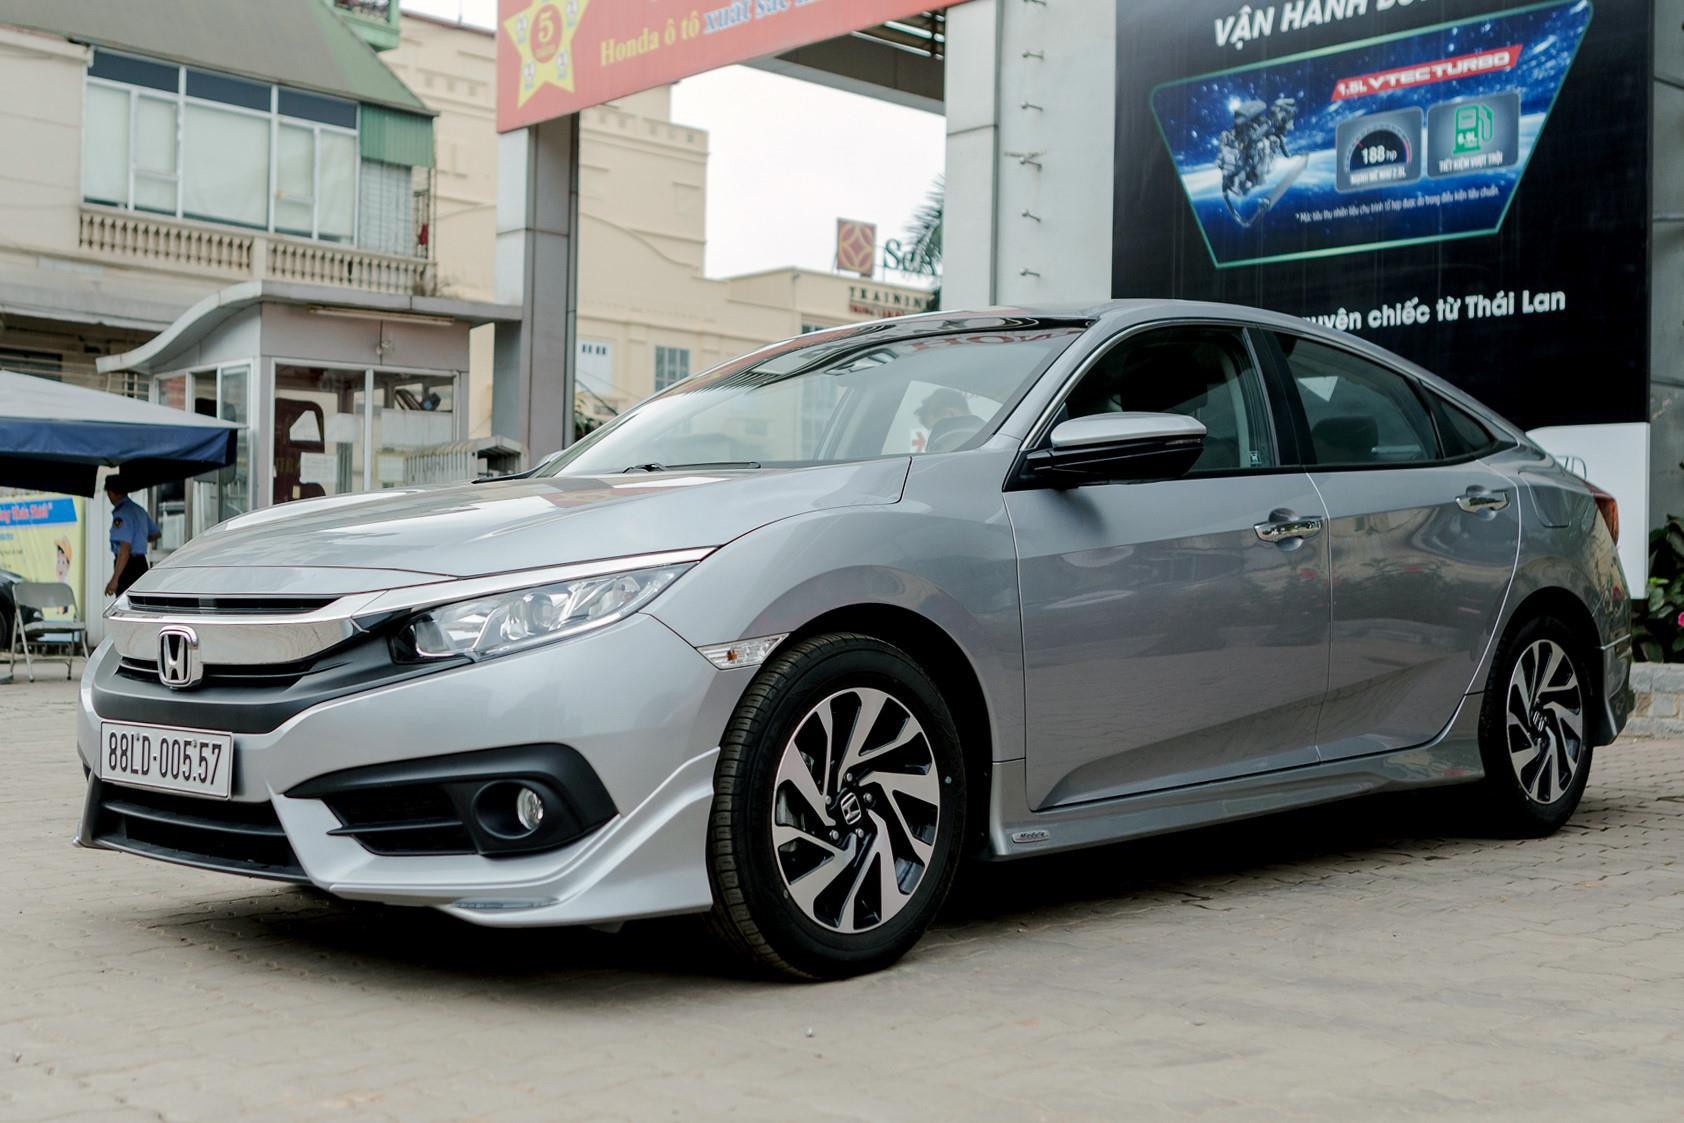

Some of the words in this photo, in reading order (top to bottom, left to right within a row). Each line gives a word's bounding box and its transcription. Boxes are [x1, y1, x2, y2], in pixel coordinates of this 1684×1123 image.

[600, 28, 659, 66] Honda
[1214, 5, 1275, 50] VẬN
[1368, 67, 1430, 89] VTEC
[1431, 51, 1511, 78] TURBO
[1367, 296, 1431, 329] chiếc
[1465, 289, 1515, 319] Thái
[1522, 289, 1567, 314] Lan
